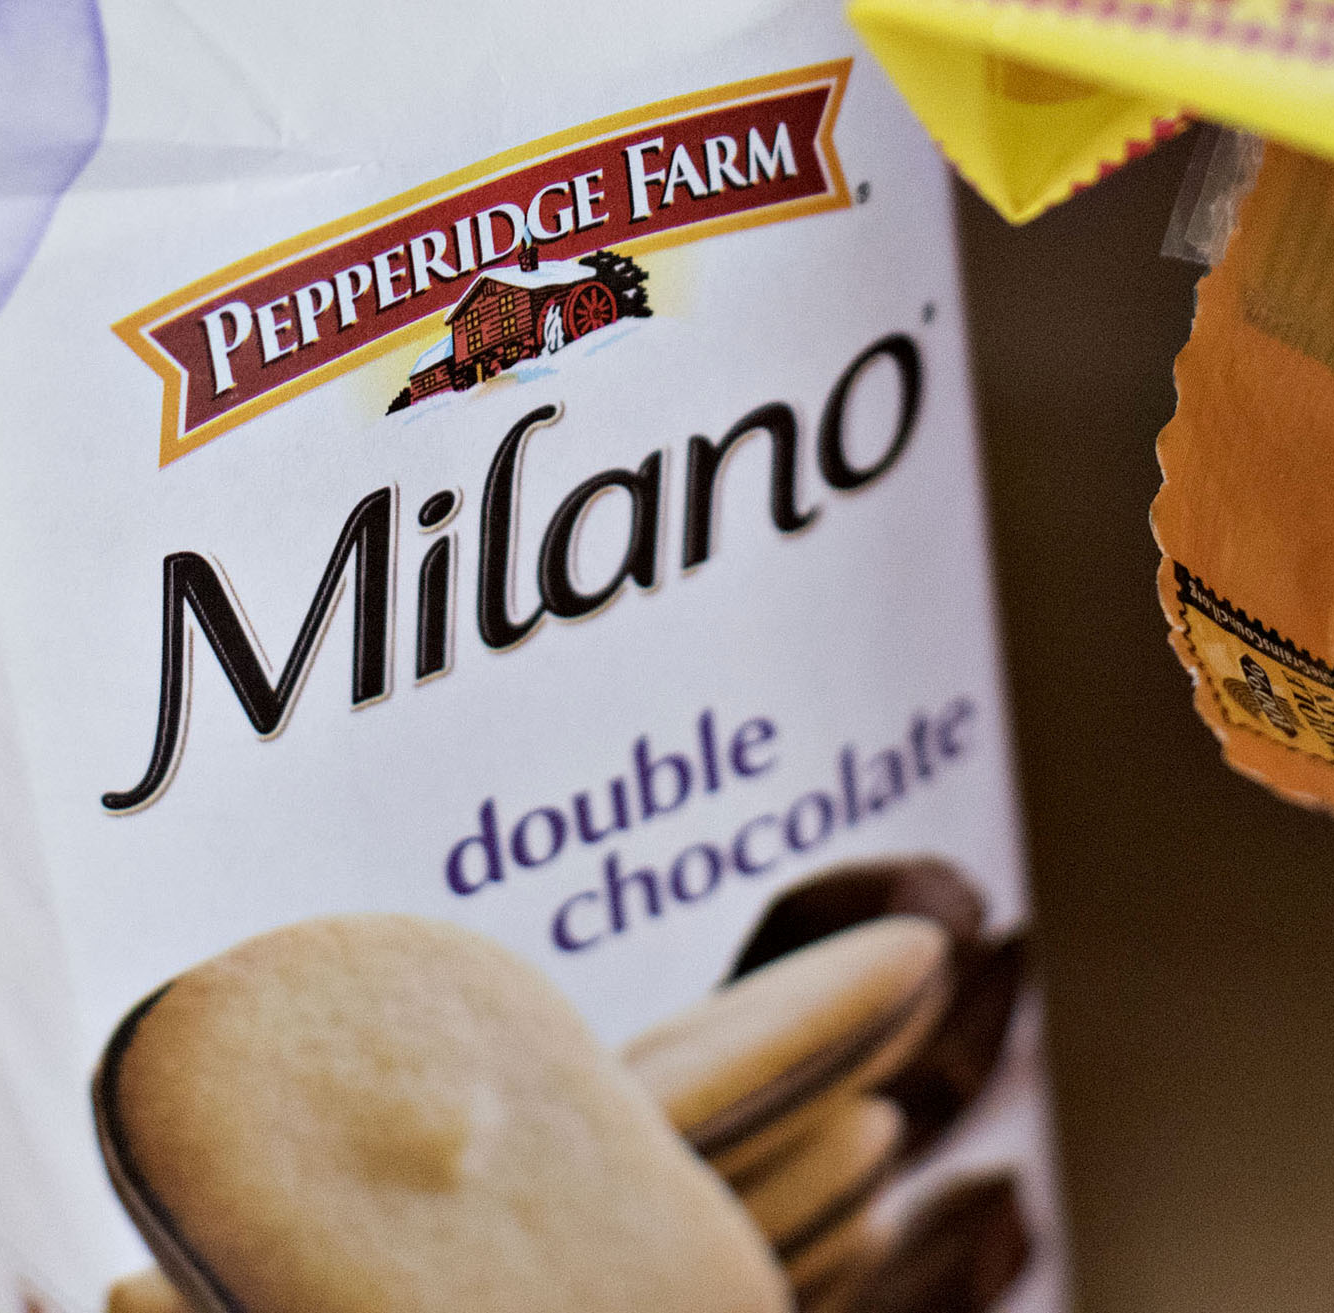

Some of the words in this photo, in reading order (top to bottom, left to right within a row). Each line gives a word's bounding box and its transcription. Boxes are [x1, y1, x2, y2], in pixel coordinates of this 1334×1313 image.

[204, 168, 607, 399] PEPPERIDGE
[625, 121, 799, 225] FARM
[100, 328, 929, 816] Milano
[442, 706, 780, 899] double
[550, 690, 977, 958] chocolate
